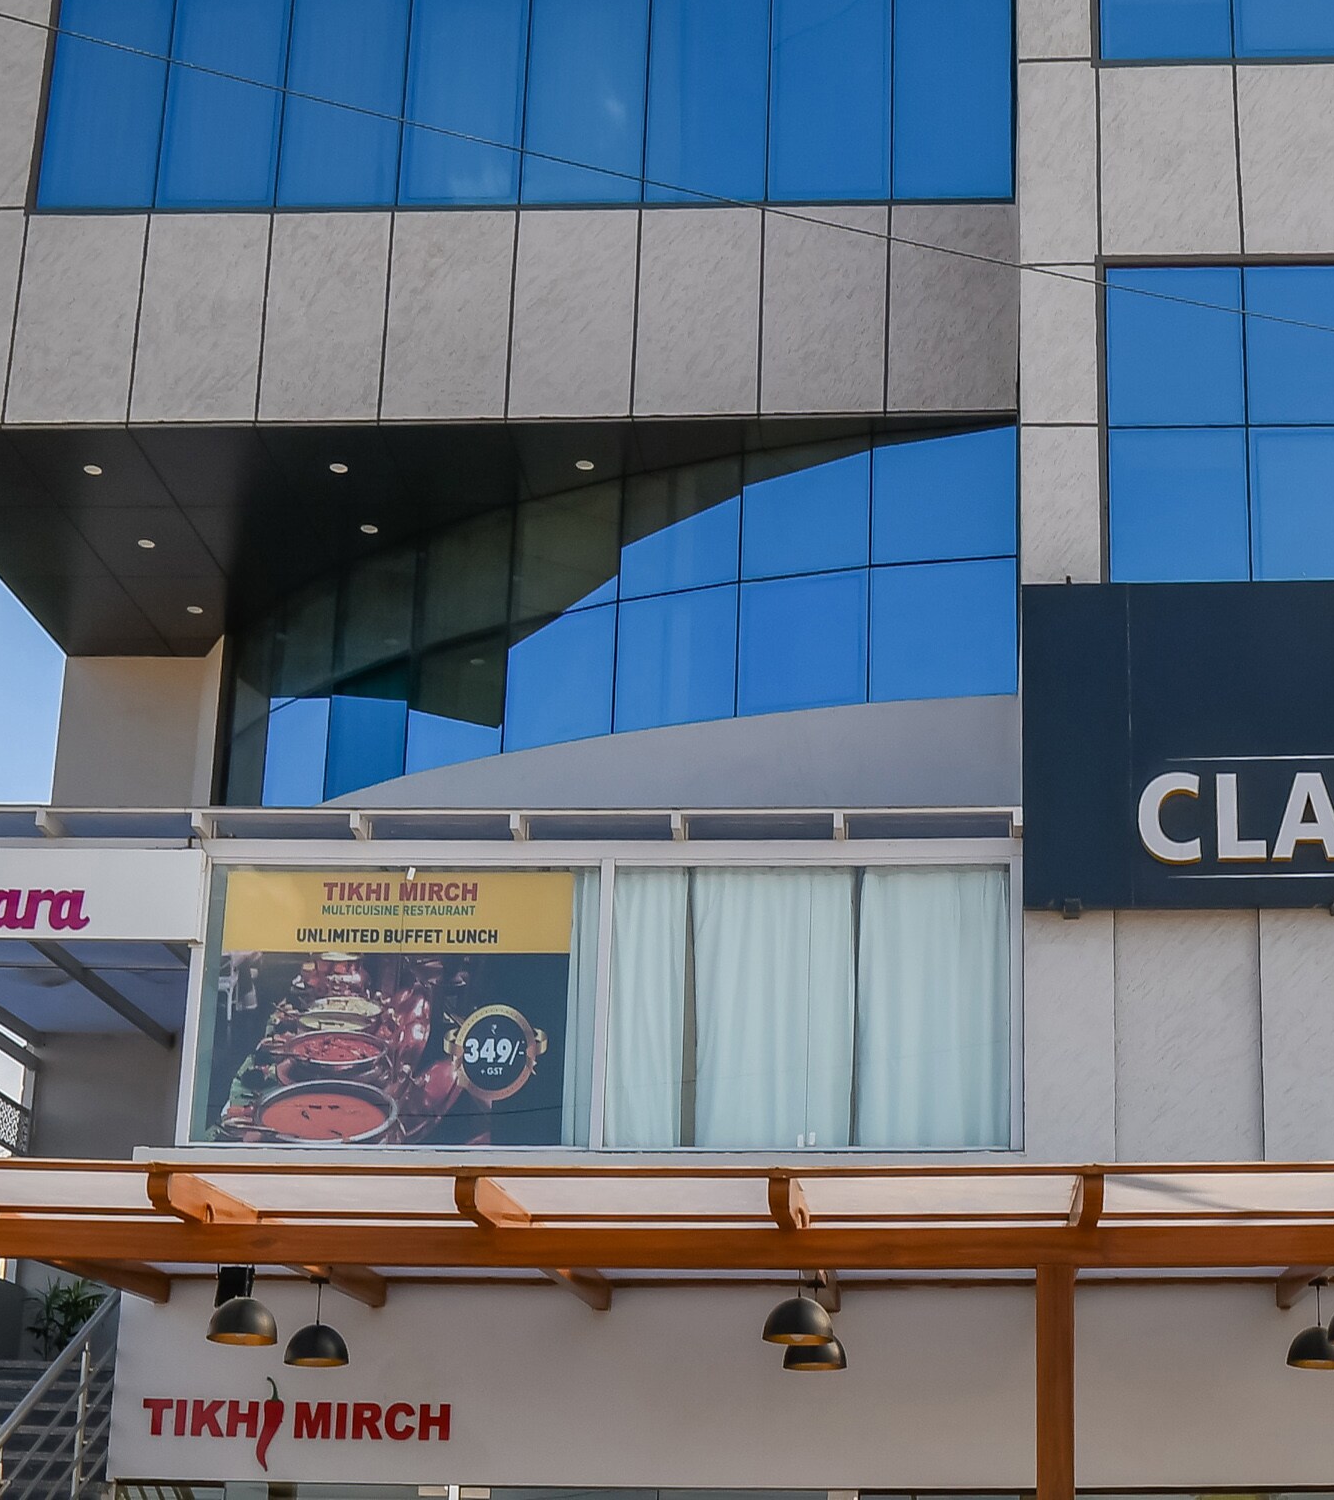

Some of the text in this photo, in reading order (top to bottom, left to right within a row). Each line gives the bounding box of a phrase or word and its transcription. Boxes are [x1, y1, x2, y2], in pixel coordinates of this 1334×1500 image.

[323, 882, 478, 902] TIKHI MIRCH
[321, 904, 476, 916] MULTICUISINE RESTAURANT
[296, 928, 499, 944] UNLIMITED BUFFET LUNCH
[463, 1038, 525, 1066] 349/-
[487, 1066, 504, 1076] GST
[293, 1401, 452, 1441] MIRCH
